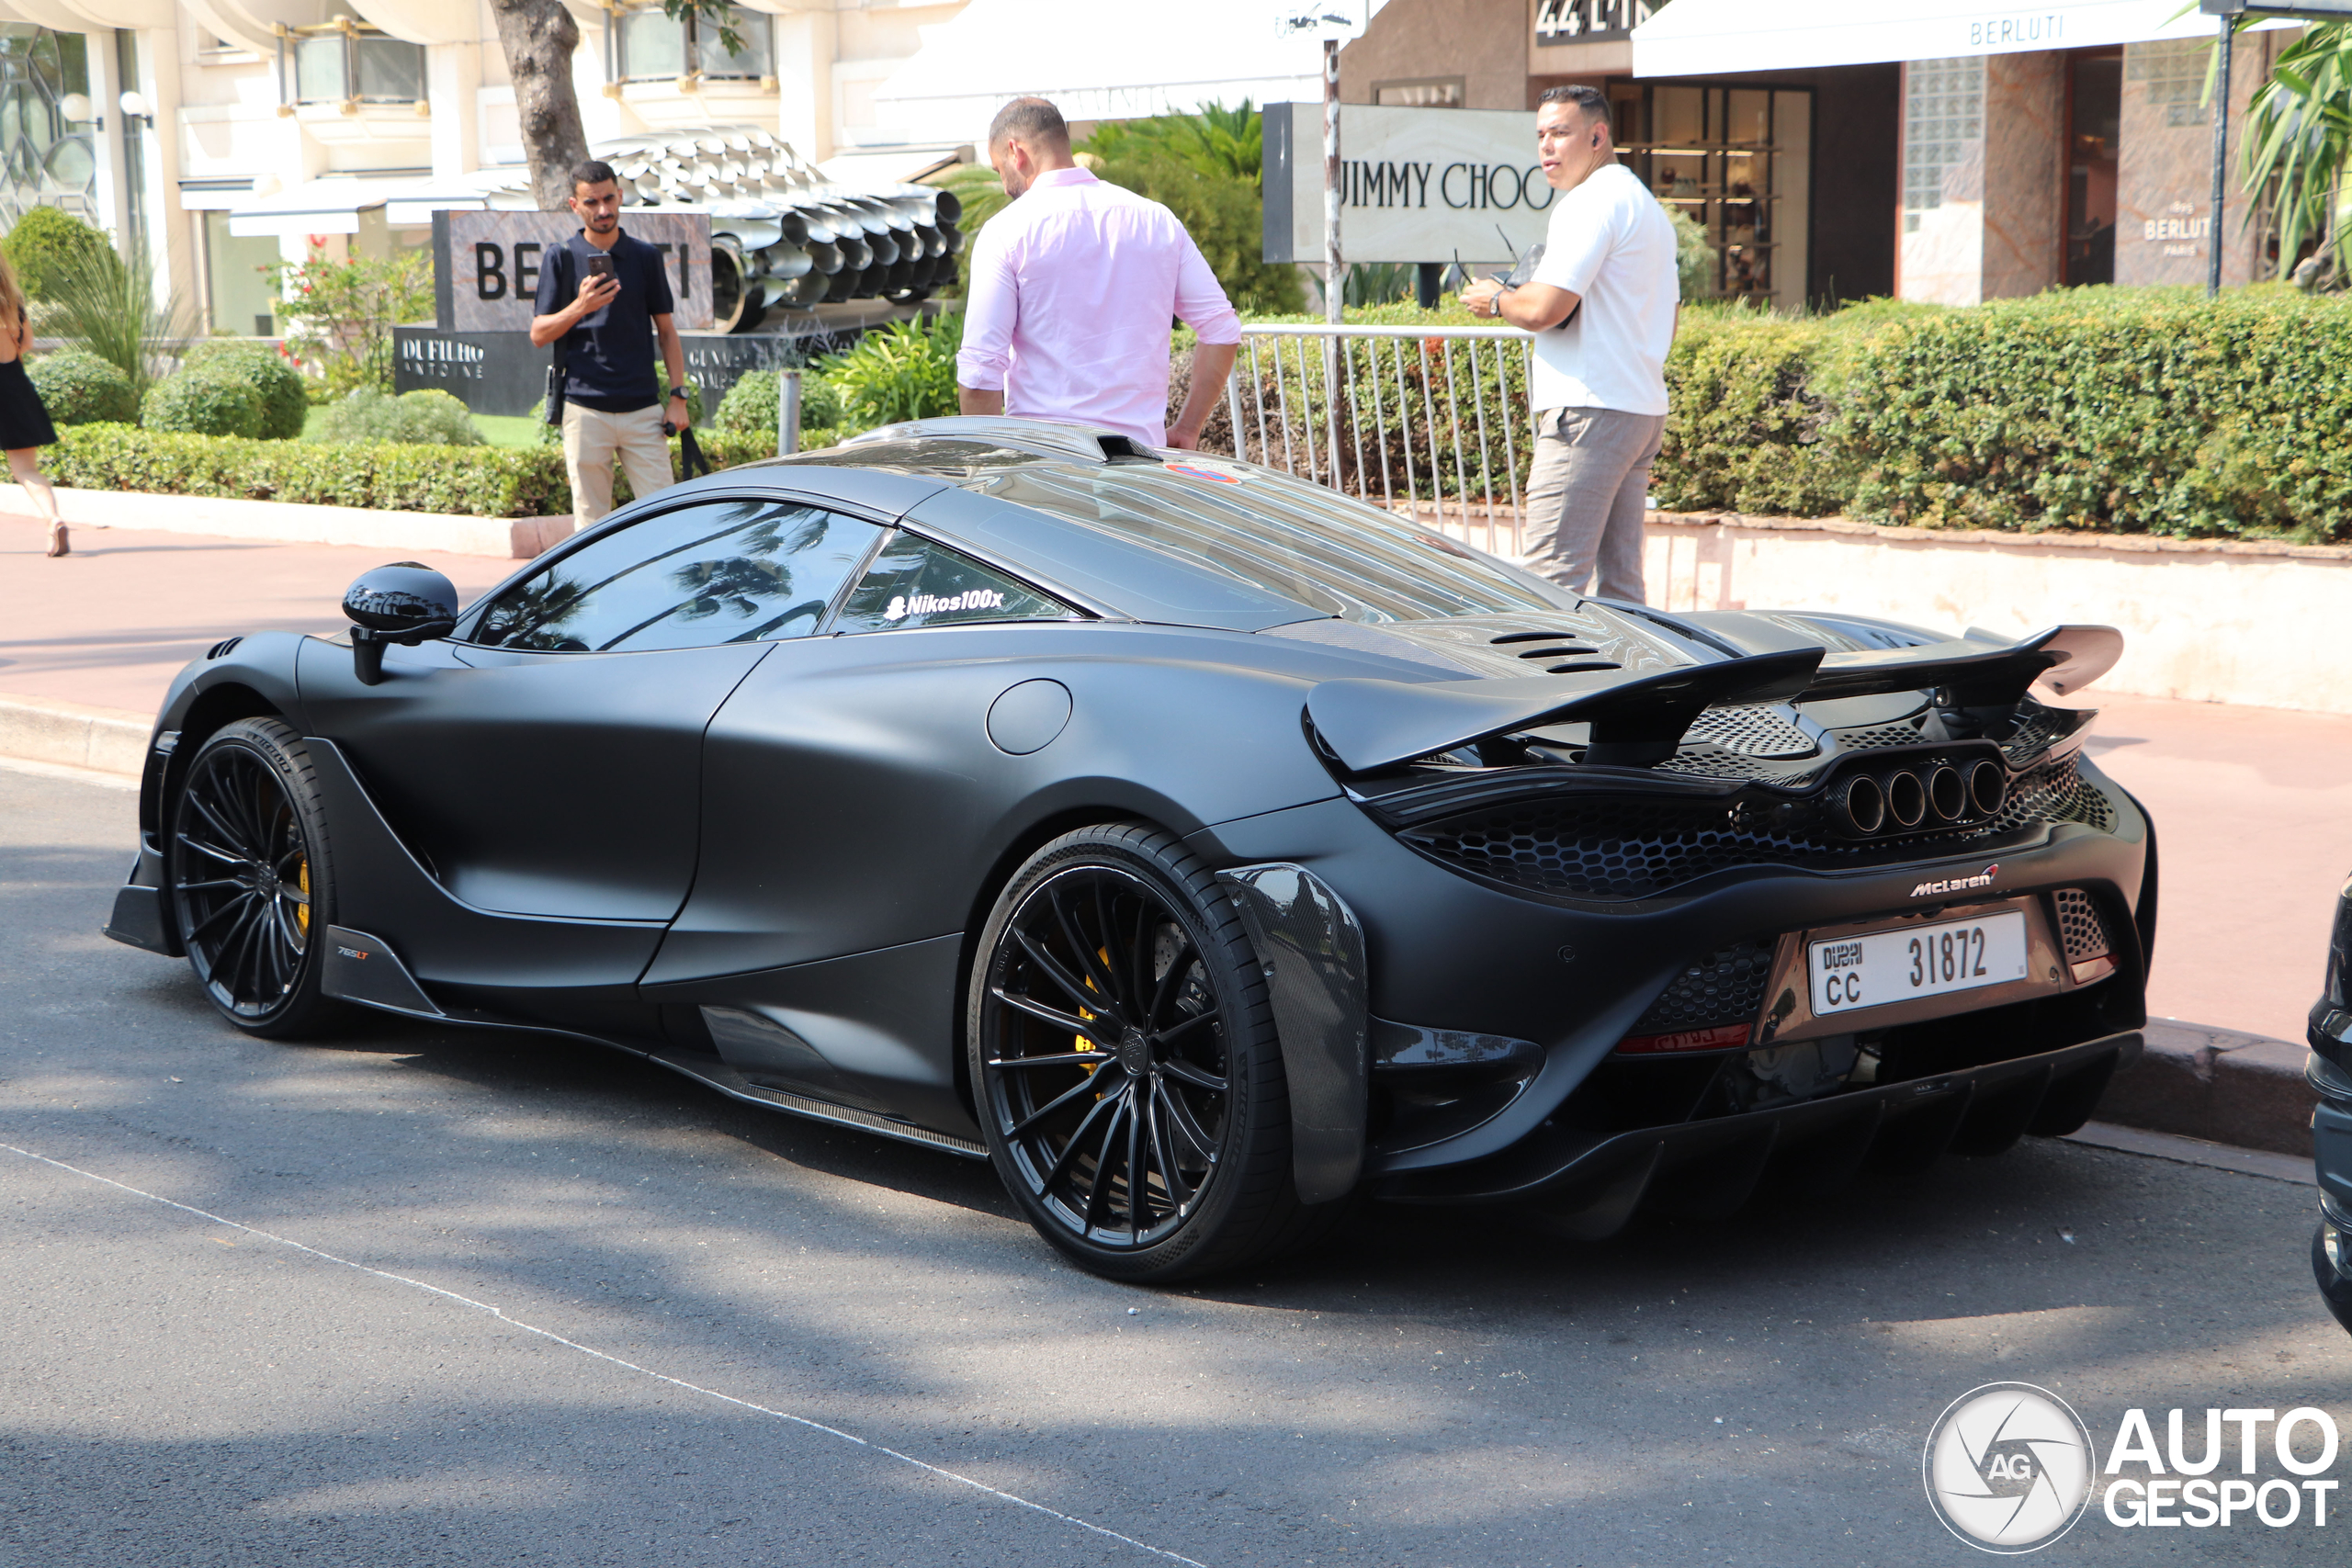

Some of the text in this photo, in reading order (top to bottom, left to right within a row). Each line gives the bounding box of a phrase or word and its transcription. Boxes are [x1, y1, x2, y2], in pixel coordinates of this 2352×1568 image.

[1534, 0, 1580, 38] 44
[1971, 15, 2064, 46] BERLUTI
[1340, 161, 1555, 210] JIMMY CHOO
[2144, 217, 2211, 241] BERLUT
[906, 589, 1004, 615] Nikos100x
[337, 945, 368, 960] 765LT
[1908, 927, 1987, 987] 31872
